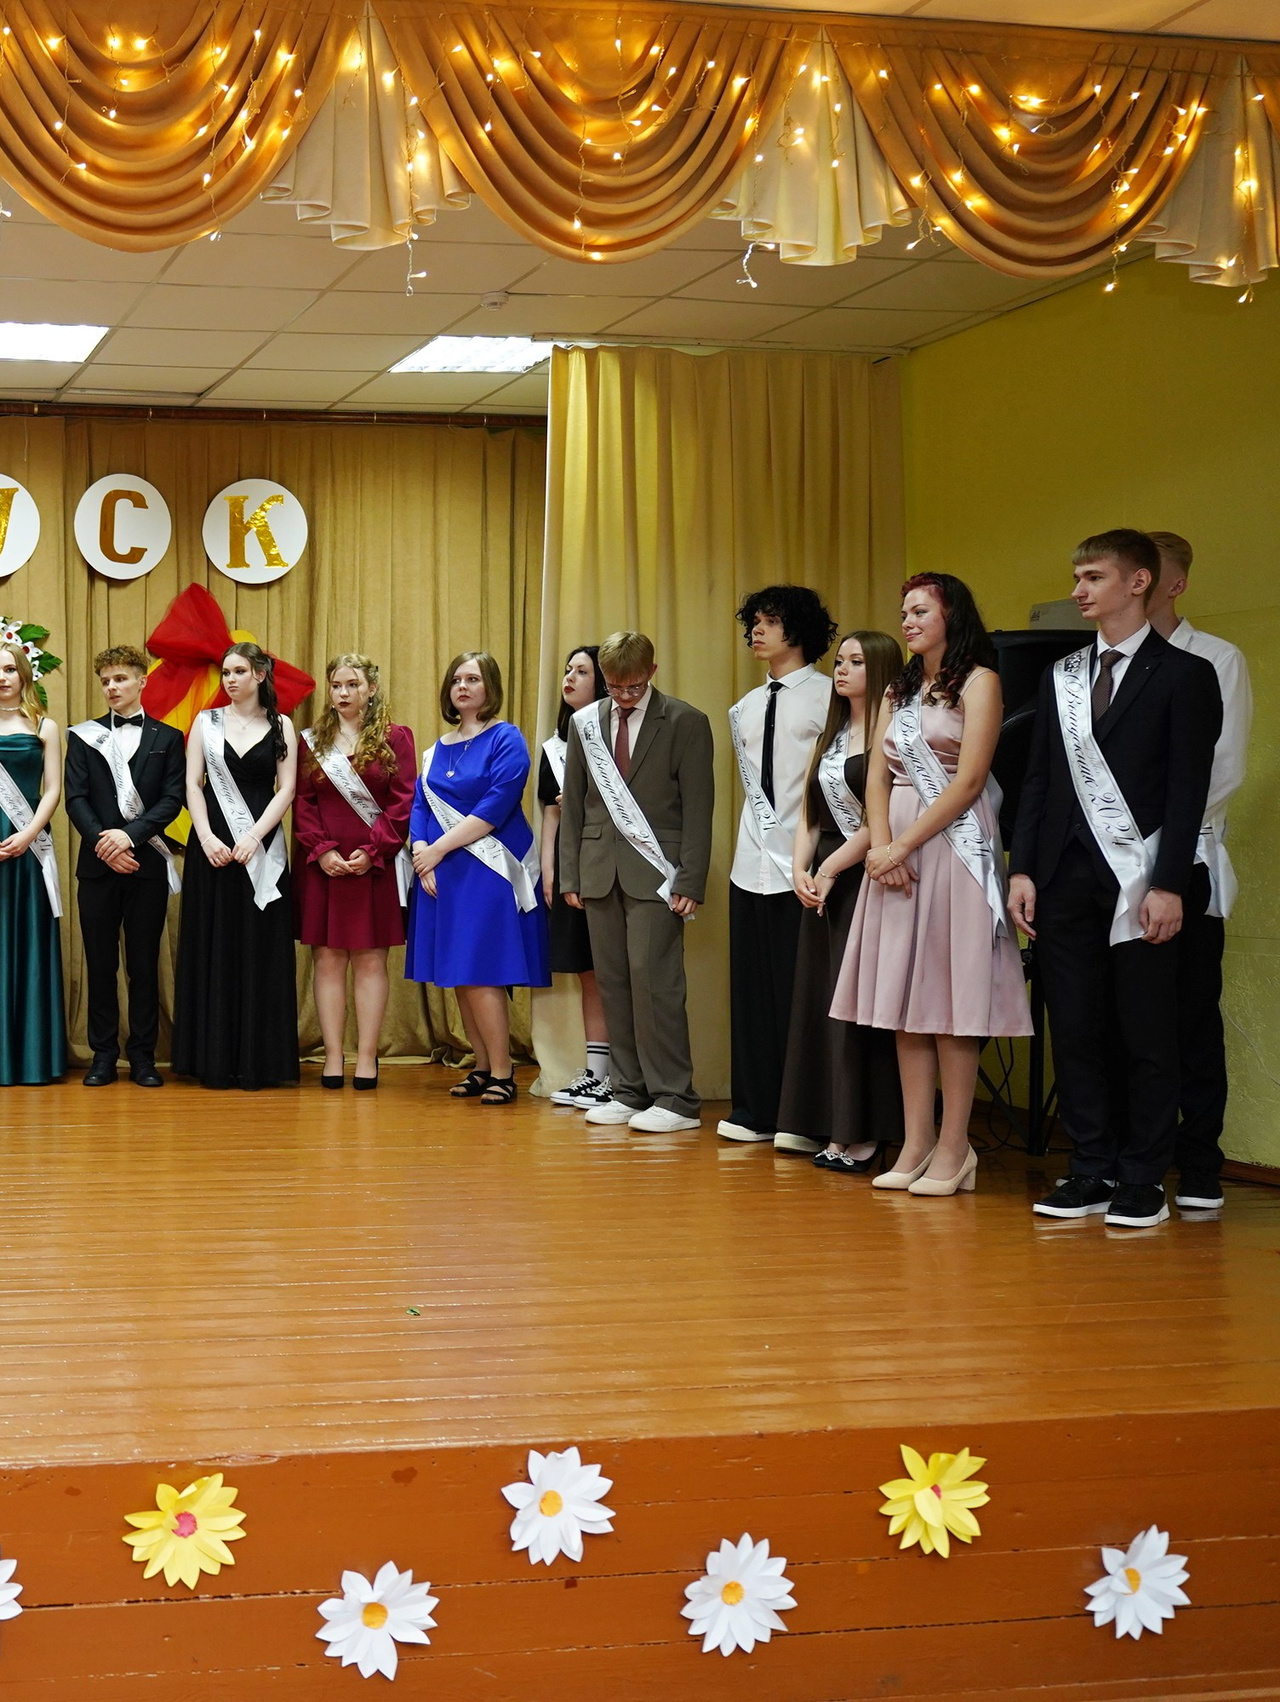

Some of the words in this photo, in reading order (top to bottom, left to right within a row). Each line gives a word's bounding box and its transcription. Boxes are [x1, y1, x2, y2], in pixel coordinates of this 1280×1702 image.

[587, 742, 635, 828] Выпускник
[899, 709, 941, 798] Выпускниц
[1063, 675, 1099, 788] Выпускник
[1088, 792, 1136, 848] 2024
[750, 790, 776, 831] 2024
